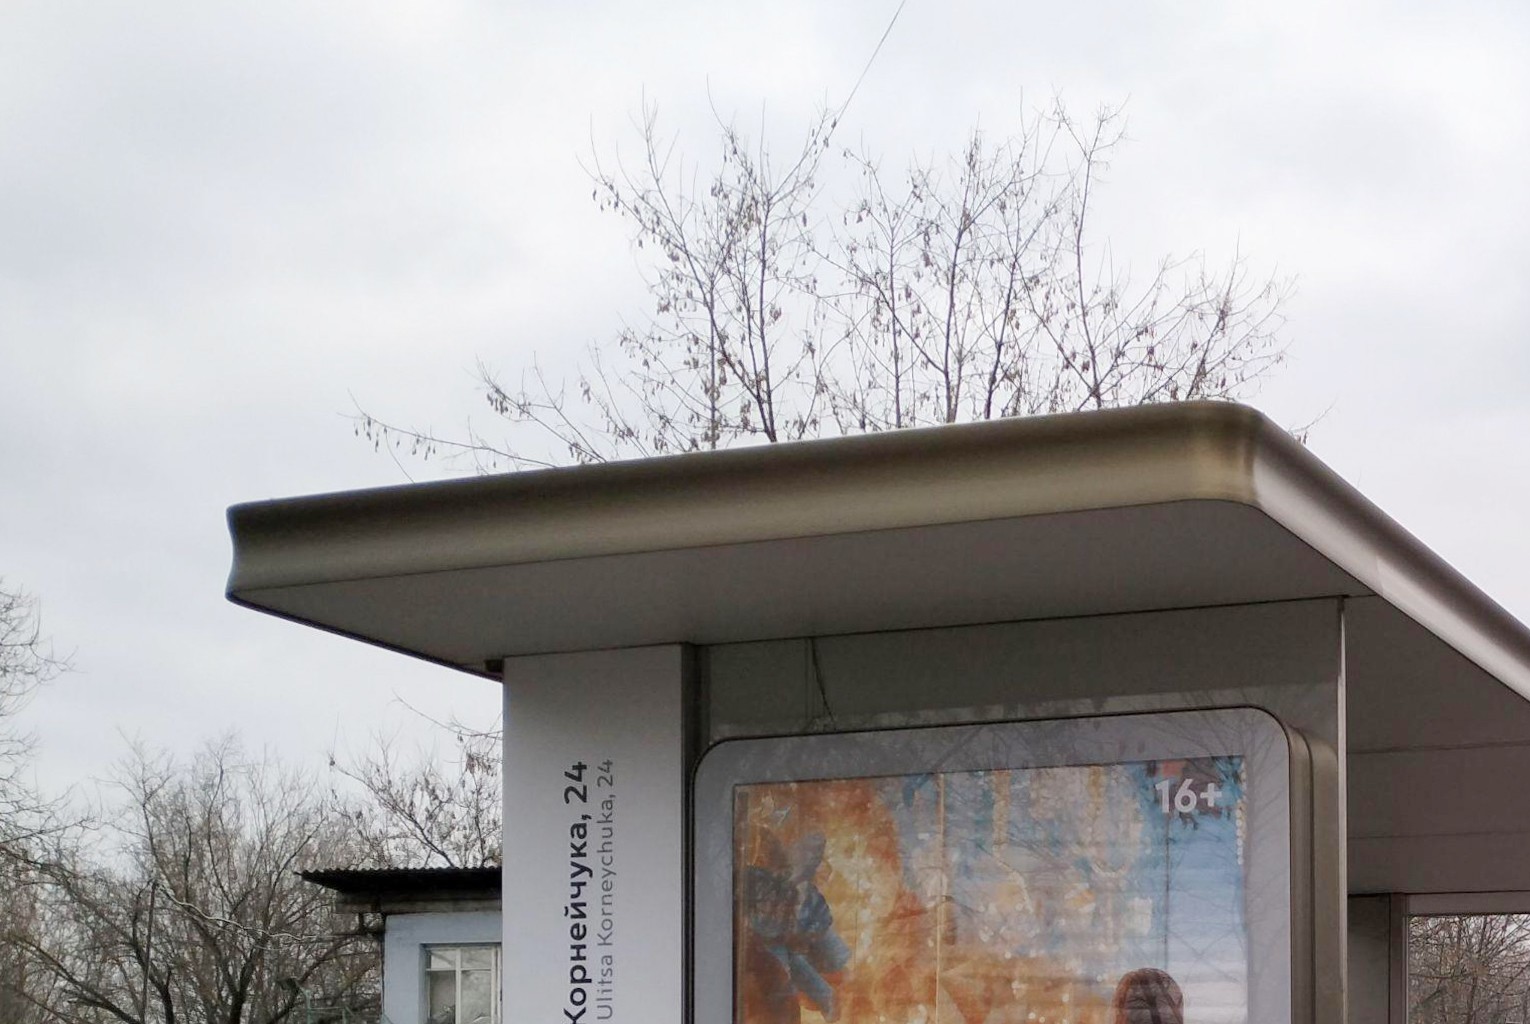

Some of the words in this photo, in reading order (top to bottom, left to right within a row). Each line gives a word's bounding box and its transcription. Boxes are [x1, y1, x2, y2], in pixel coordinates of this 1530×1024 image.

[564, 761, 588, 806] 24
[597, 759, 613, 789] 24
[1155, 778, 1222, 813] 16+
[597, 793, 617, 946] Korneychuka,
[597, 953, 613, 1020] Ulitsa
